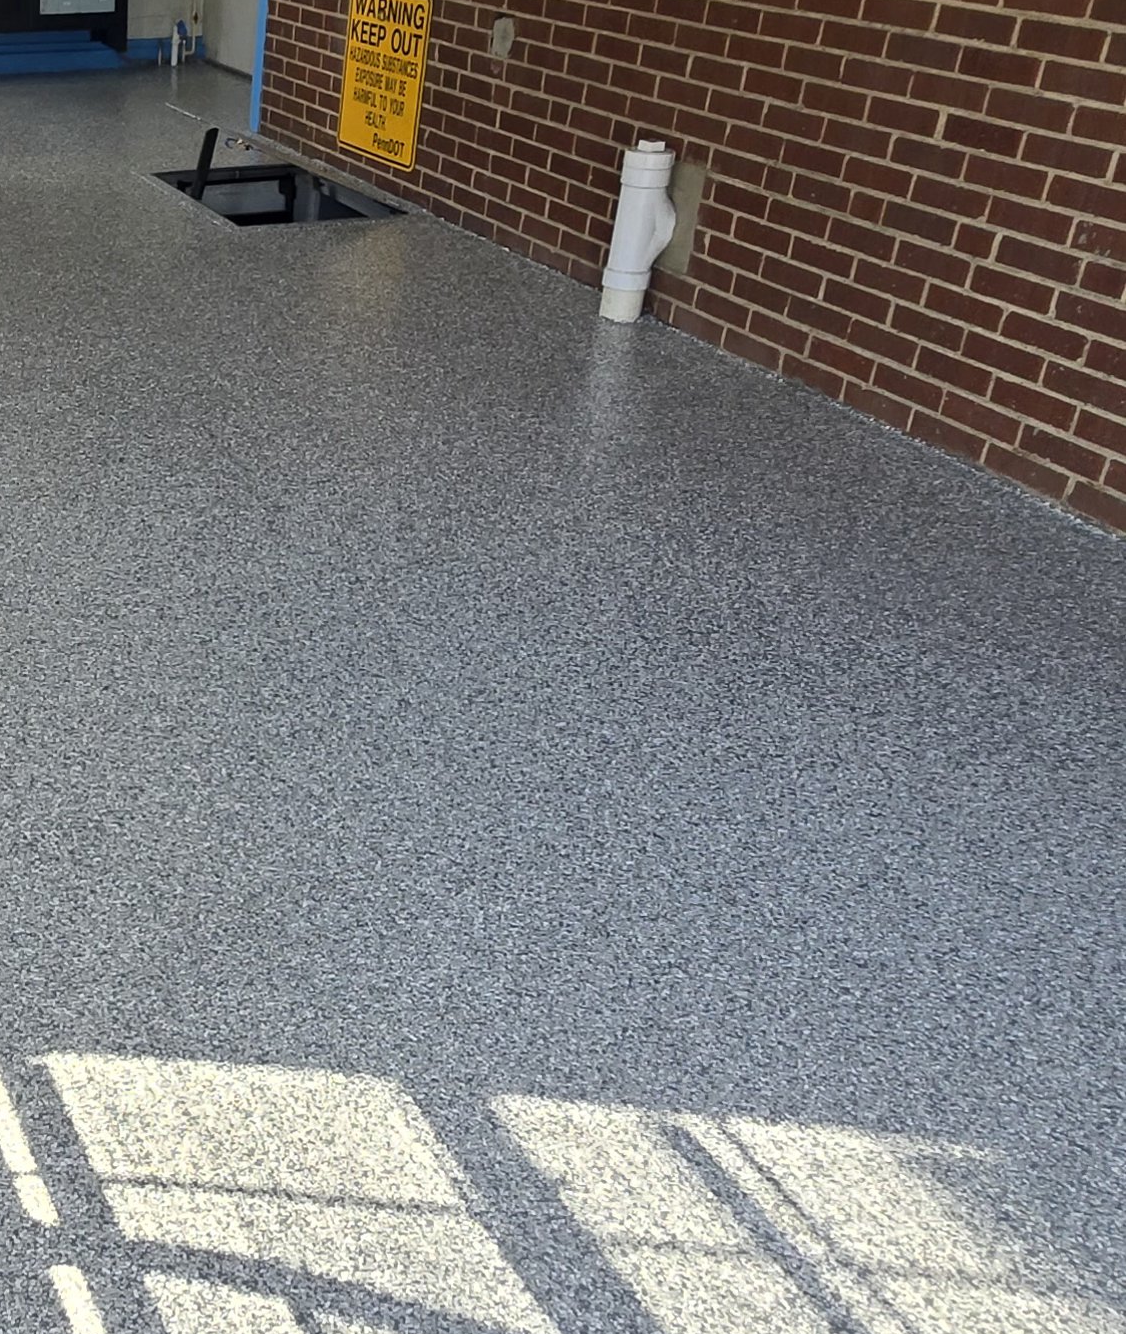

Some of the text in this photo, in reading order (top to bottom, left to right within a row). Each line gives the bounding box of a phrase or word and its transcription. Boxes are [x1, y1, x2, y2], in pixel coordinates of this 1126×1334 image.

[351, 19, 423, 58] KEEP OUT
[350, 46, 419, 80] HAZARDOUS SUBSTANCES
[355, 67, 407, 97] EXPOSURE MAY BE
[353, 86, 405, 117] HARMFUL TO YOUR
[372, 132, 405, 158] PennDOT
